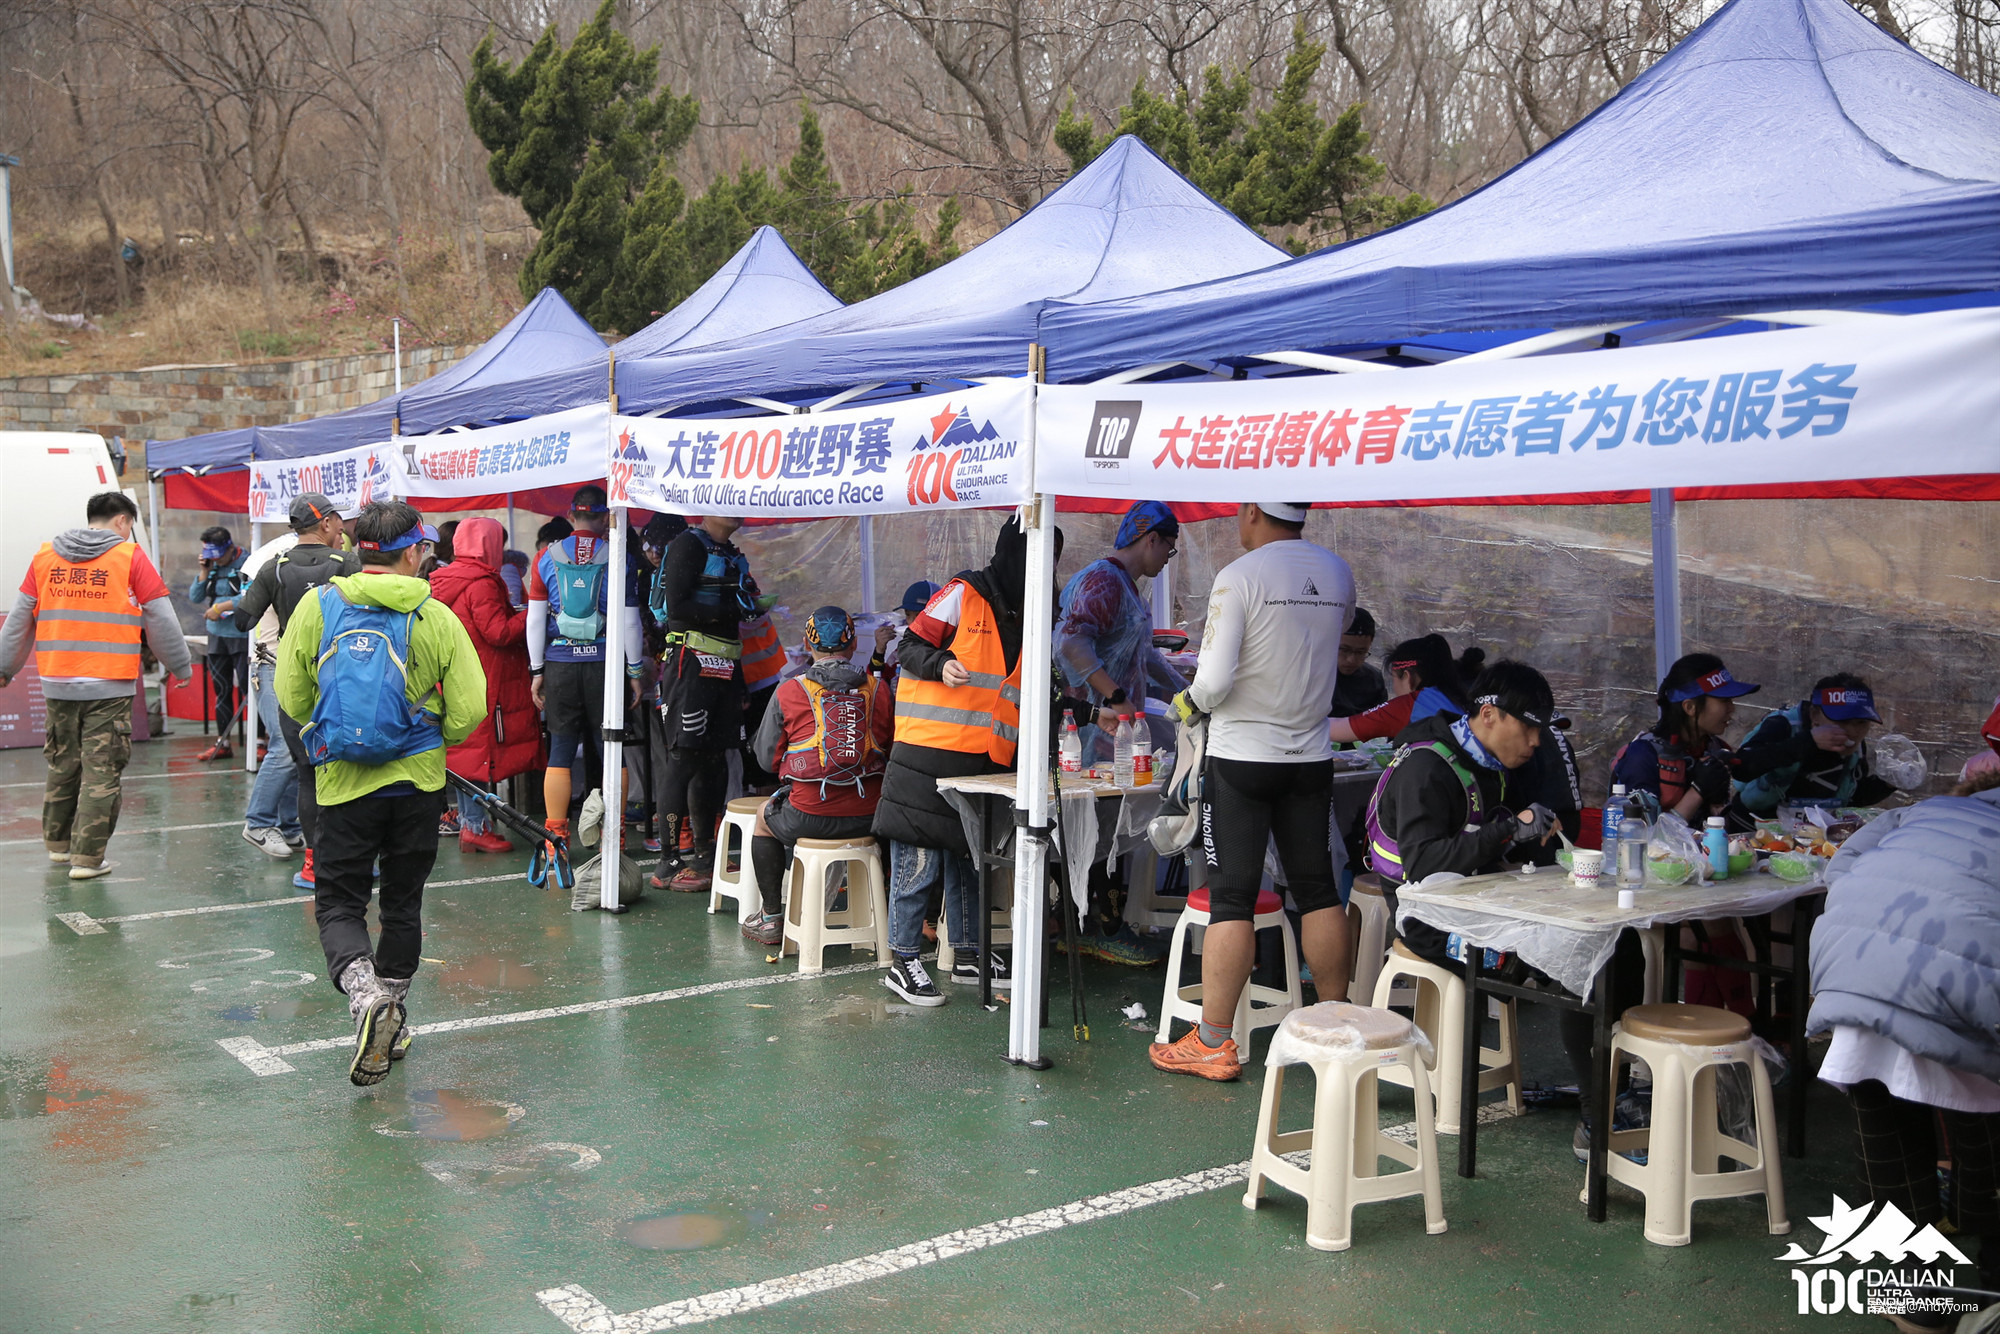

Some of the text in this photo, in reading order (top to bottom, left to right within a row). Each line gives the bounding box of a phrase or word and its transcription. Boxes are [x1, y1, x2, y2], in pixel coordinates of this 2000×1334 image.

[1152, 363, 1858, 471] 大连滔搏体育志愿者为您服务
[1095, 417, 1130, 456] TOP
[662, 417, 895, 480] 大连100越野赛
[960, 441, 1017, 465] DALIAN
[632, 463, 656, 478] DALIAN
[957, 465, 983, 477] ULTRA
[956, 474, 1008, 489] ENDURANCE
[660, 482, 884, 507] Dalian 100 Ultra Endurance Race
[957, 492, 981, 502] RACE
[49, 566, 109, 587] 志愿者
[49, 587, 108, 600] Volunteer
[1288, 599, 1318, 607] Skyrunning
[572, 645, 598, 655] DL100
[845, 701, 855, 758] ULTIMATE
[1549, 725, 1582, 811] UNIVERSE
